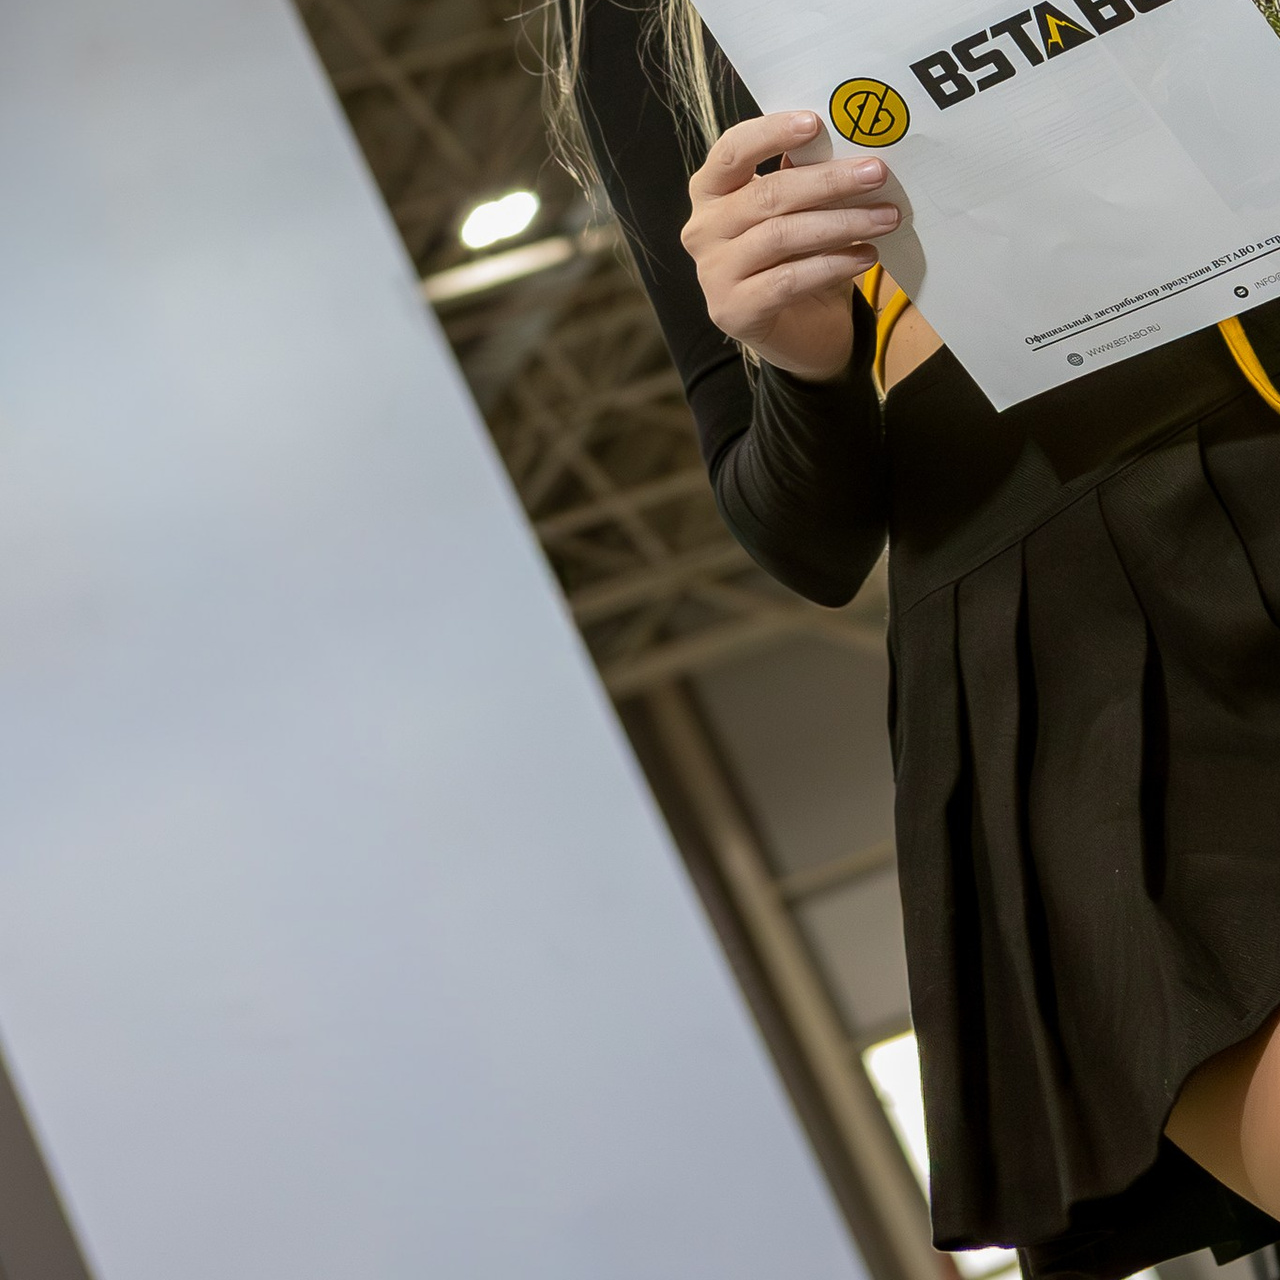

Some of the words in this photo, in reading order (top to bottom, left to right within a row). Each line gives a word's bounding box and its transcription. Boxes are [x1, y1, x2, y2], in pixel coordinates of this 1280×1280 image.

[1025, 314, 1093, 345] Официальный
[1093, 288, 1159, 319] дистрибьютор
[1160, 264, 1212, 292] продукции
[1211, 244, 1256, 269] BSTABO
[1256, 242, 1264, 250] в
[1086, 323, 1161, 357] WWW.BSTABO.RU
